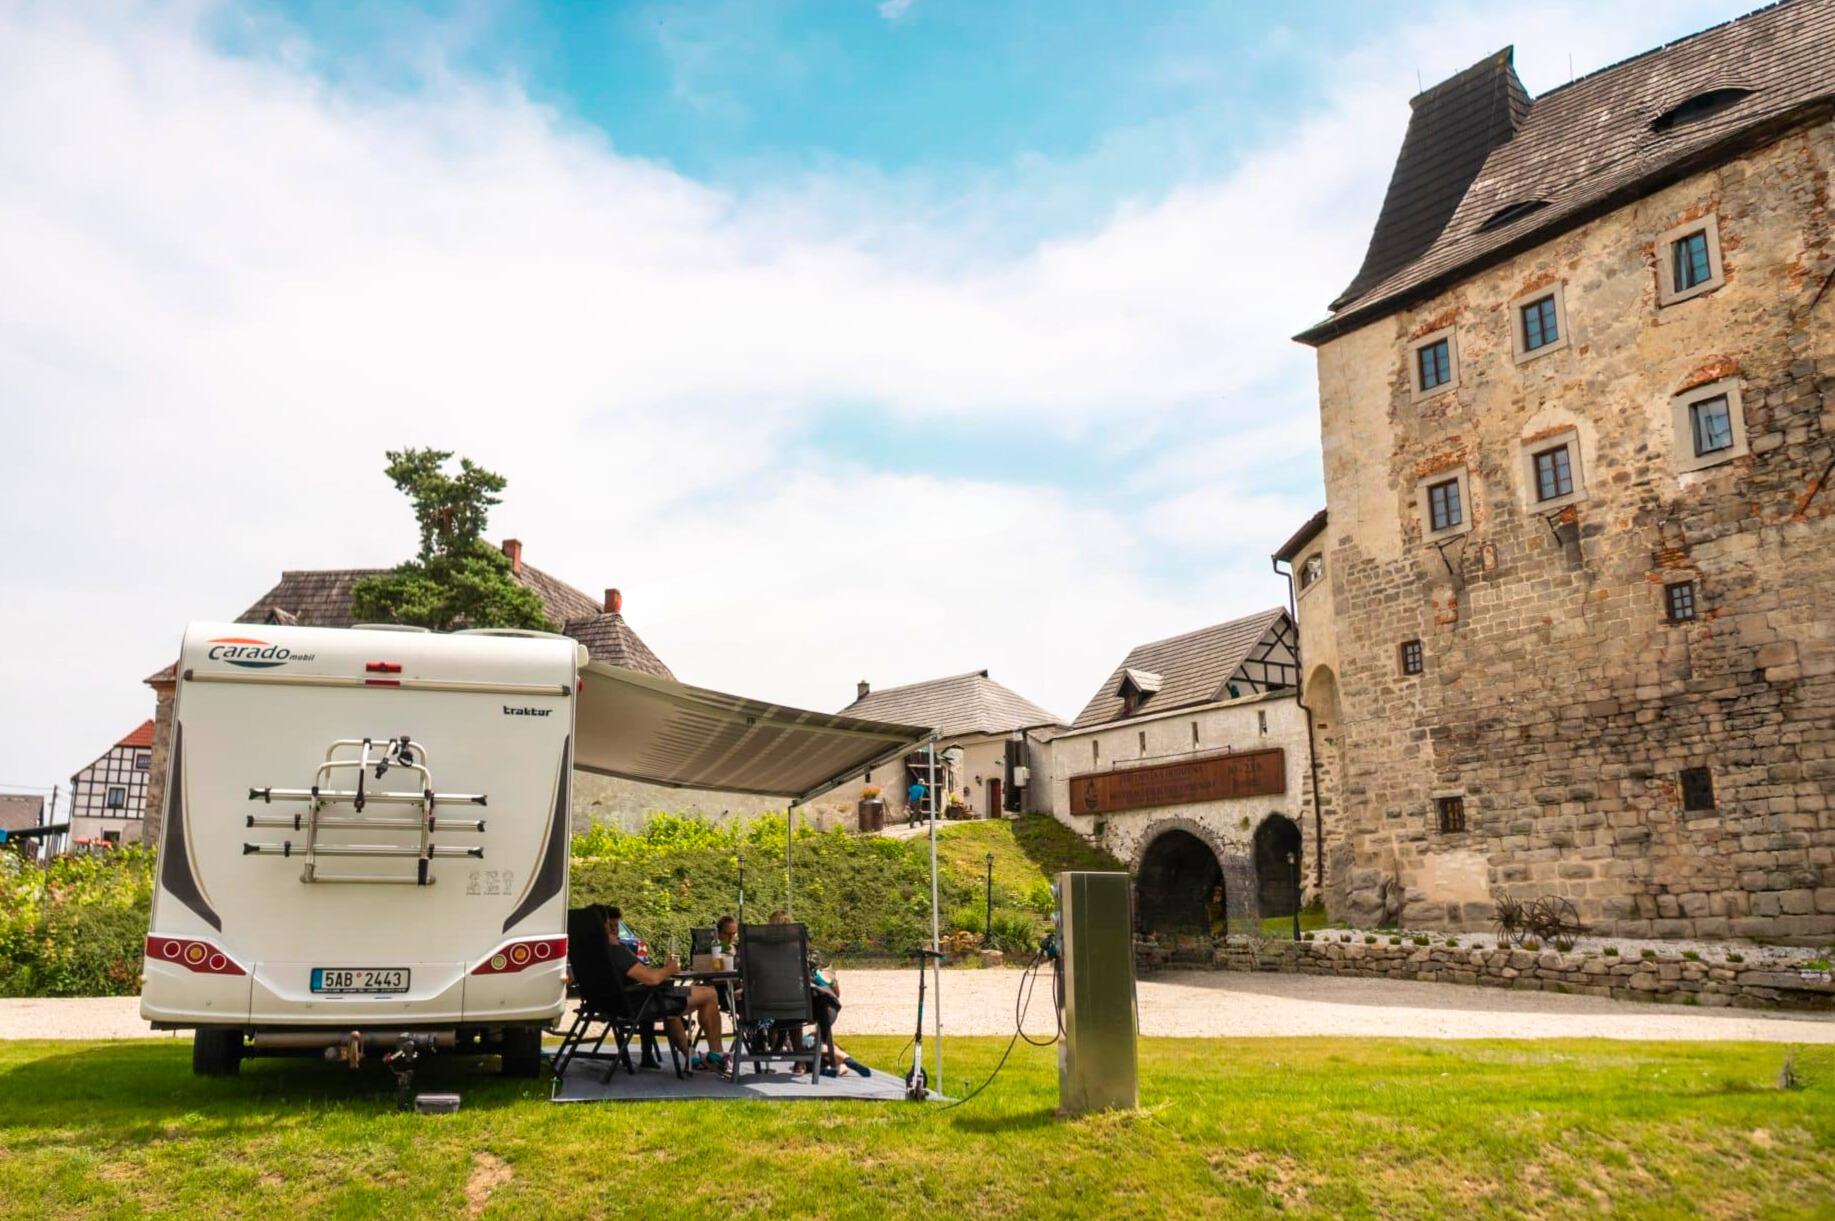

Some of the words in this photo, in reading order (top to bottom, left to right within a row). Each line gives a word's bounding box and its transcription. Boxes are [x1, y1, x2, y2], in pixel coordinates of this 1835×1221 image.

[289, 653, 316, 662] mobil
[503, 705, 553, 717] traktor
[325, 972, 353, 987] 5AB
[364, 972, 402, 987] 2443
